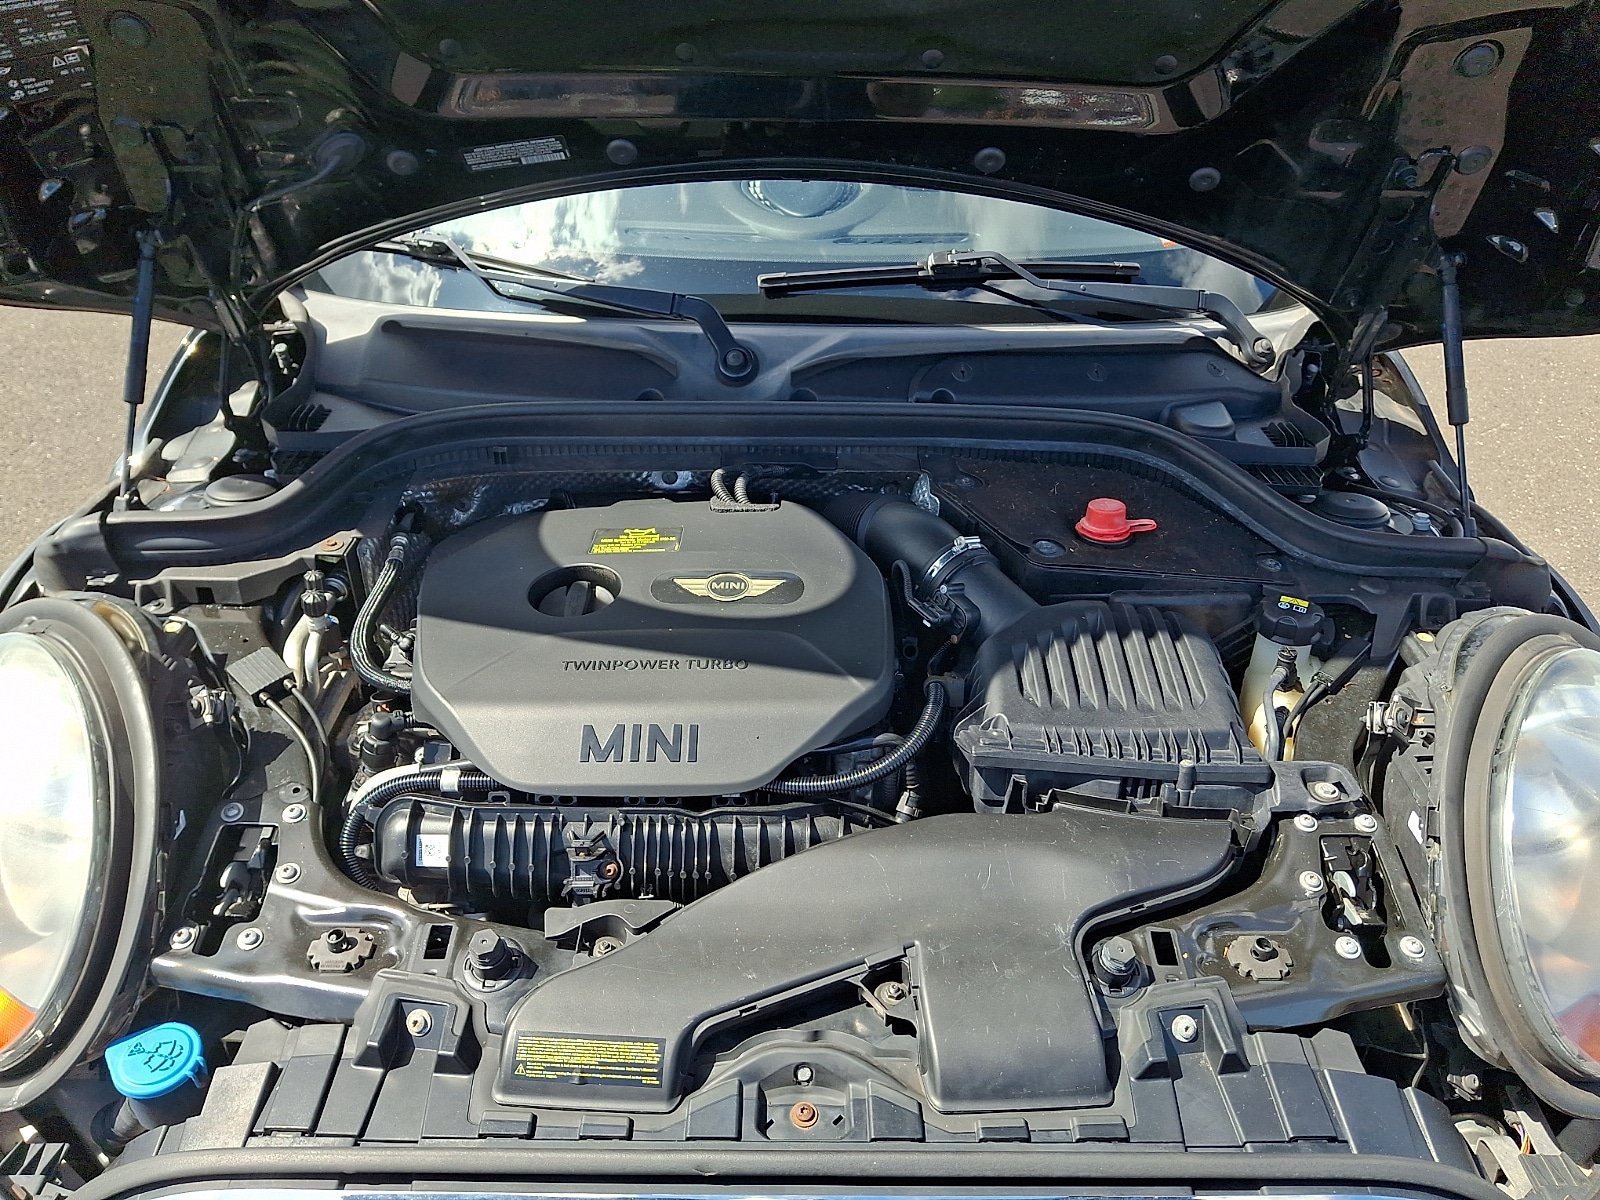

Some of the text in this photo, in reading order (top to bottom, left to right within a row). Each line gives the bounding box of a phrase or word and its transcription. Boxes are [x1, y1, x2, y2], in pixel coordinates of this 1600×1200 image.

[711, 581, 746, 590] MINI
[562, 659, 749, 671] TWINPOWER TURBO
[579, 723, 699, 762] MINI
